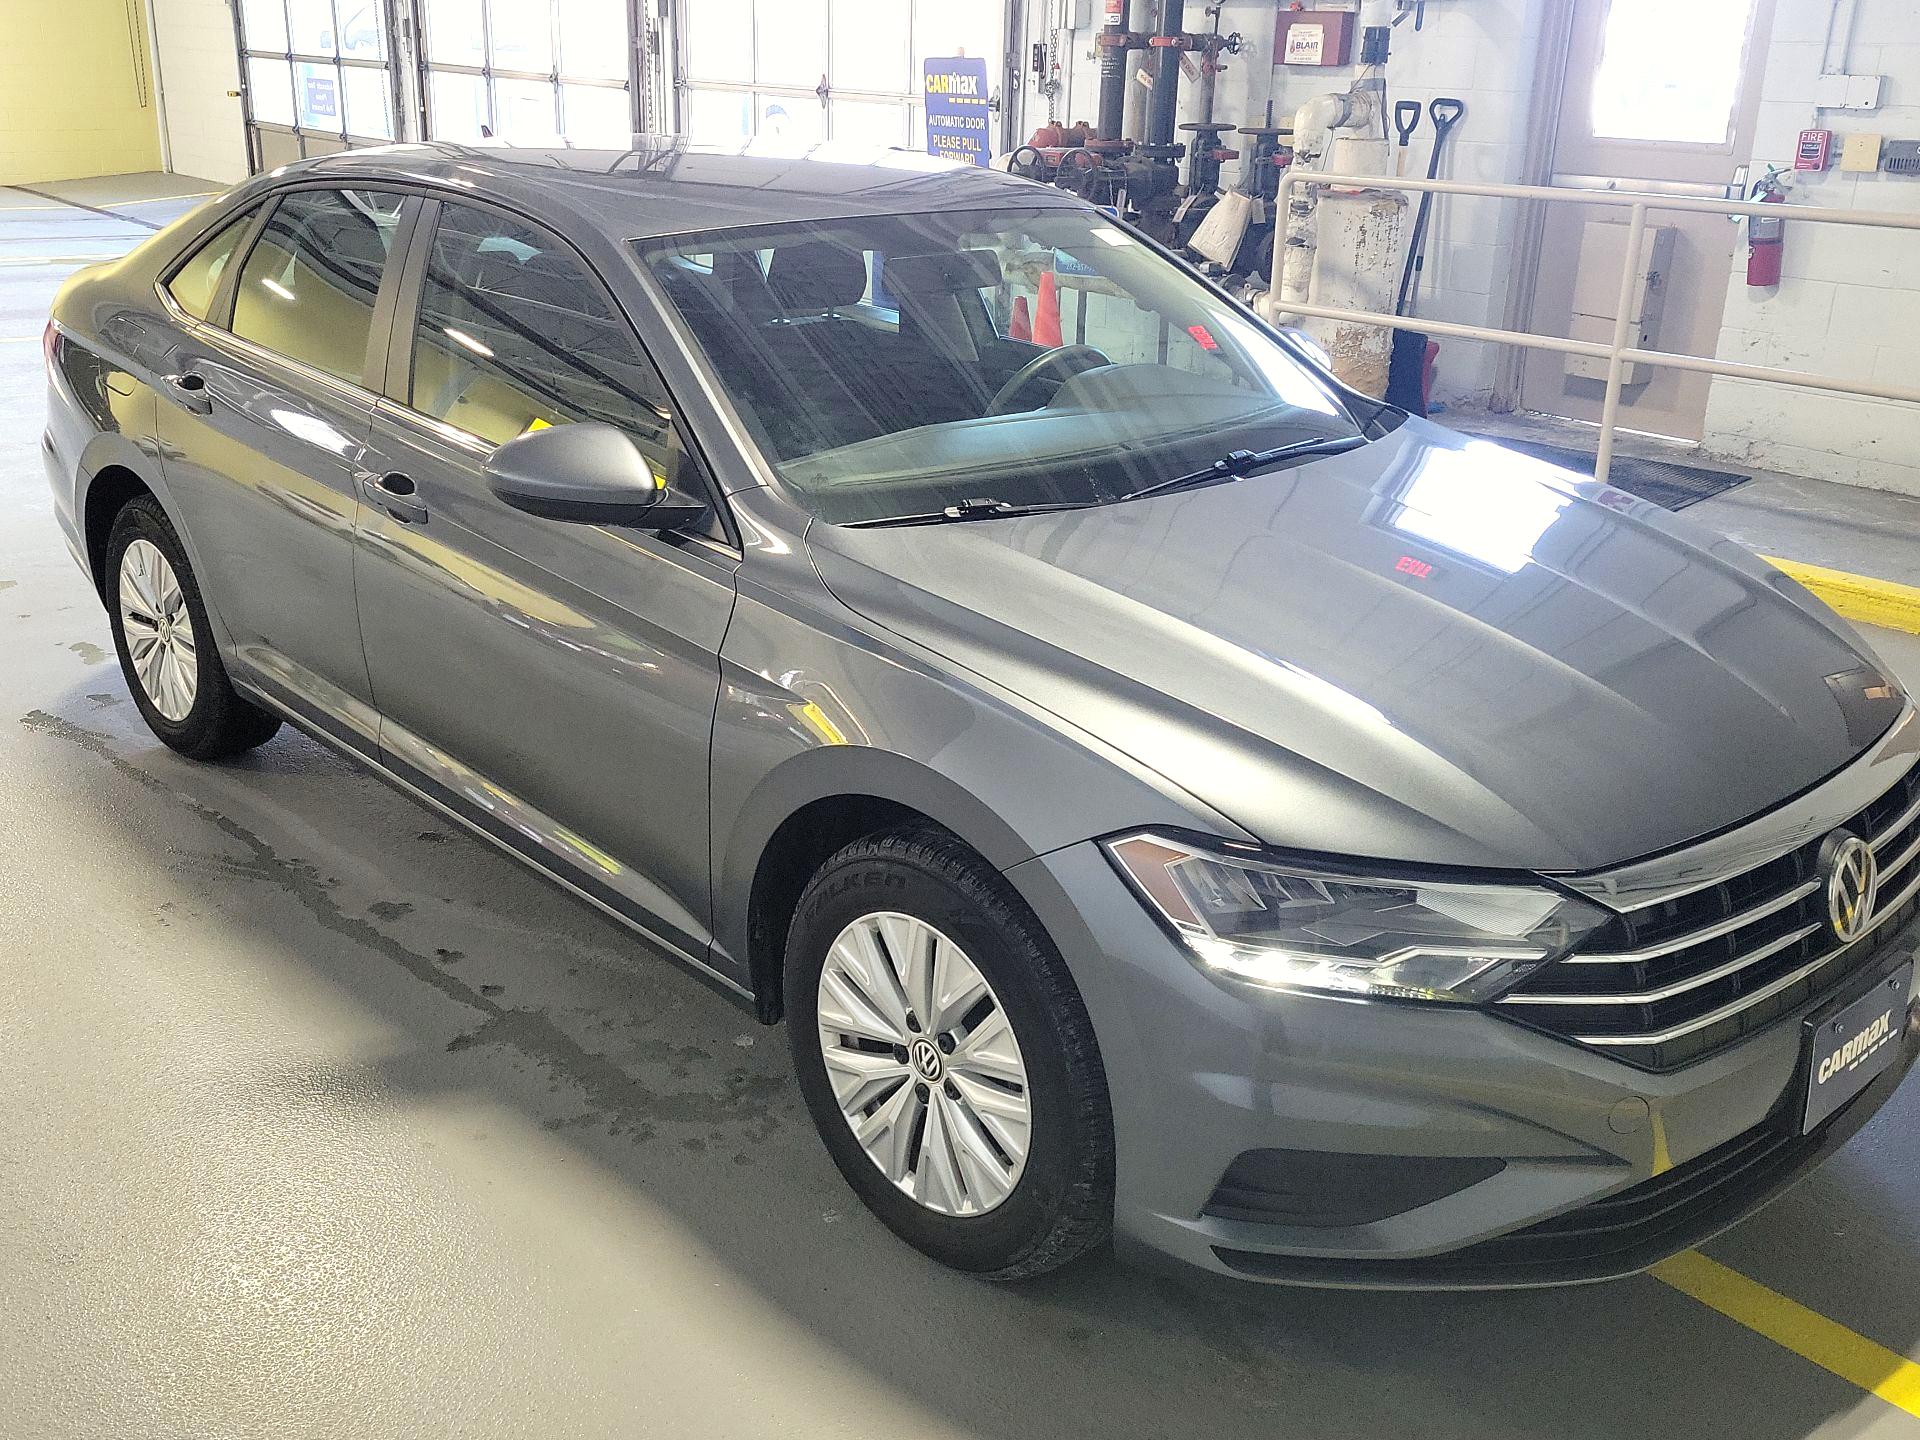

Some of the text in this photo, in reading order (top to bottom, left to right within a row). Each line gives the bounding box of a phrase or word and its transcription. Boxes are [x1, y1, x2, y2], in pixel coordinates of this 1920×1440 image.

[1295, 41, 1319, 50] BLAIR
[928, 115, 986, 131] AUTOMATIC DOOR
[932, 134, 982, 152] PLEASE PULL
[1801, 132, 1824, 142] FIRE
